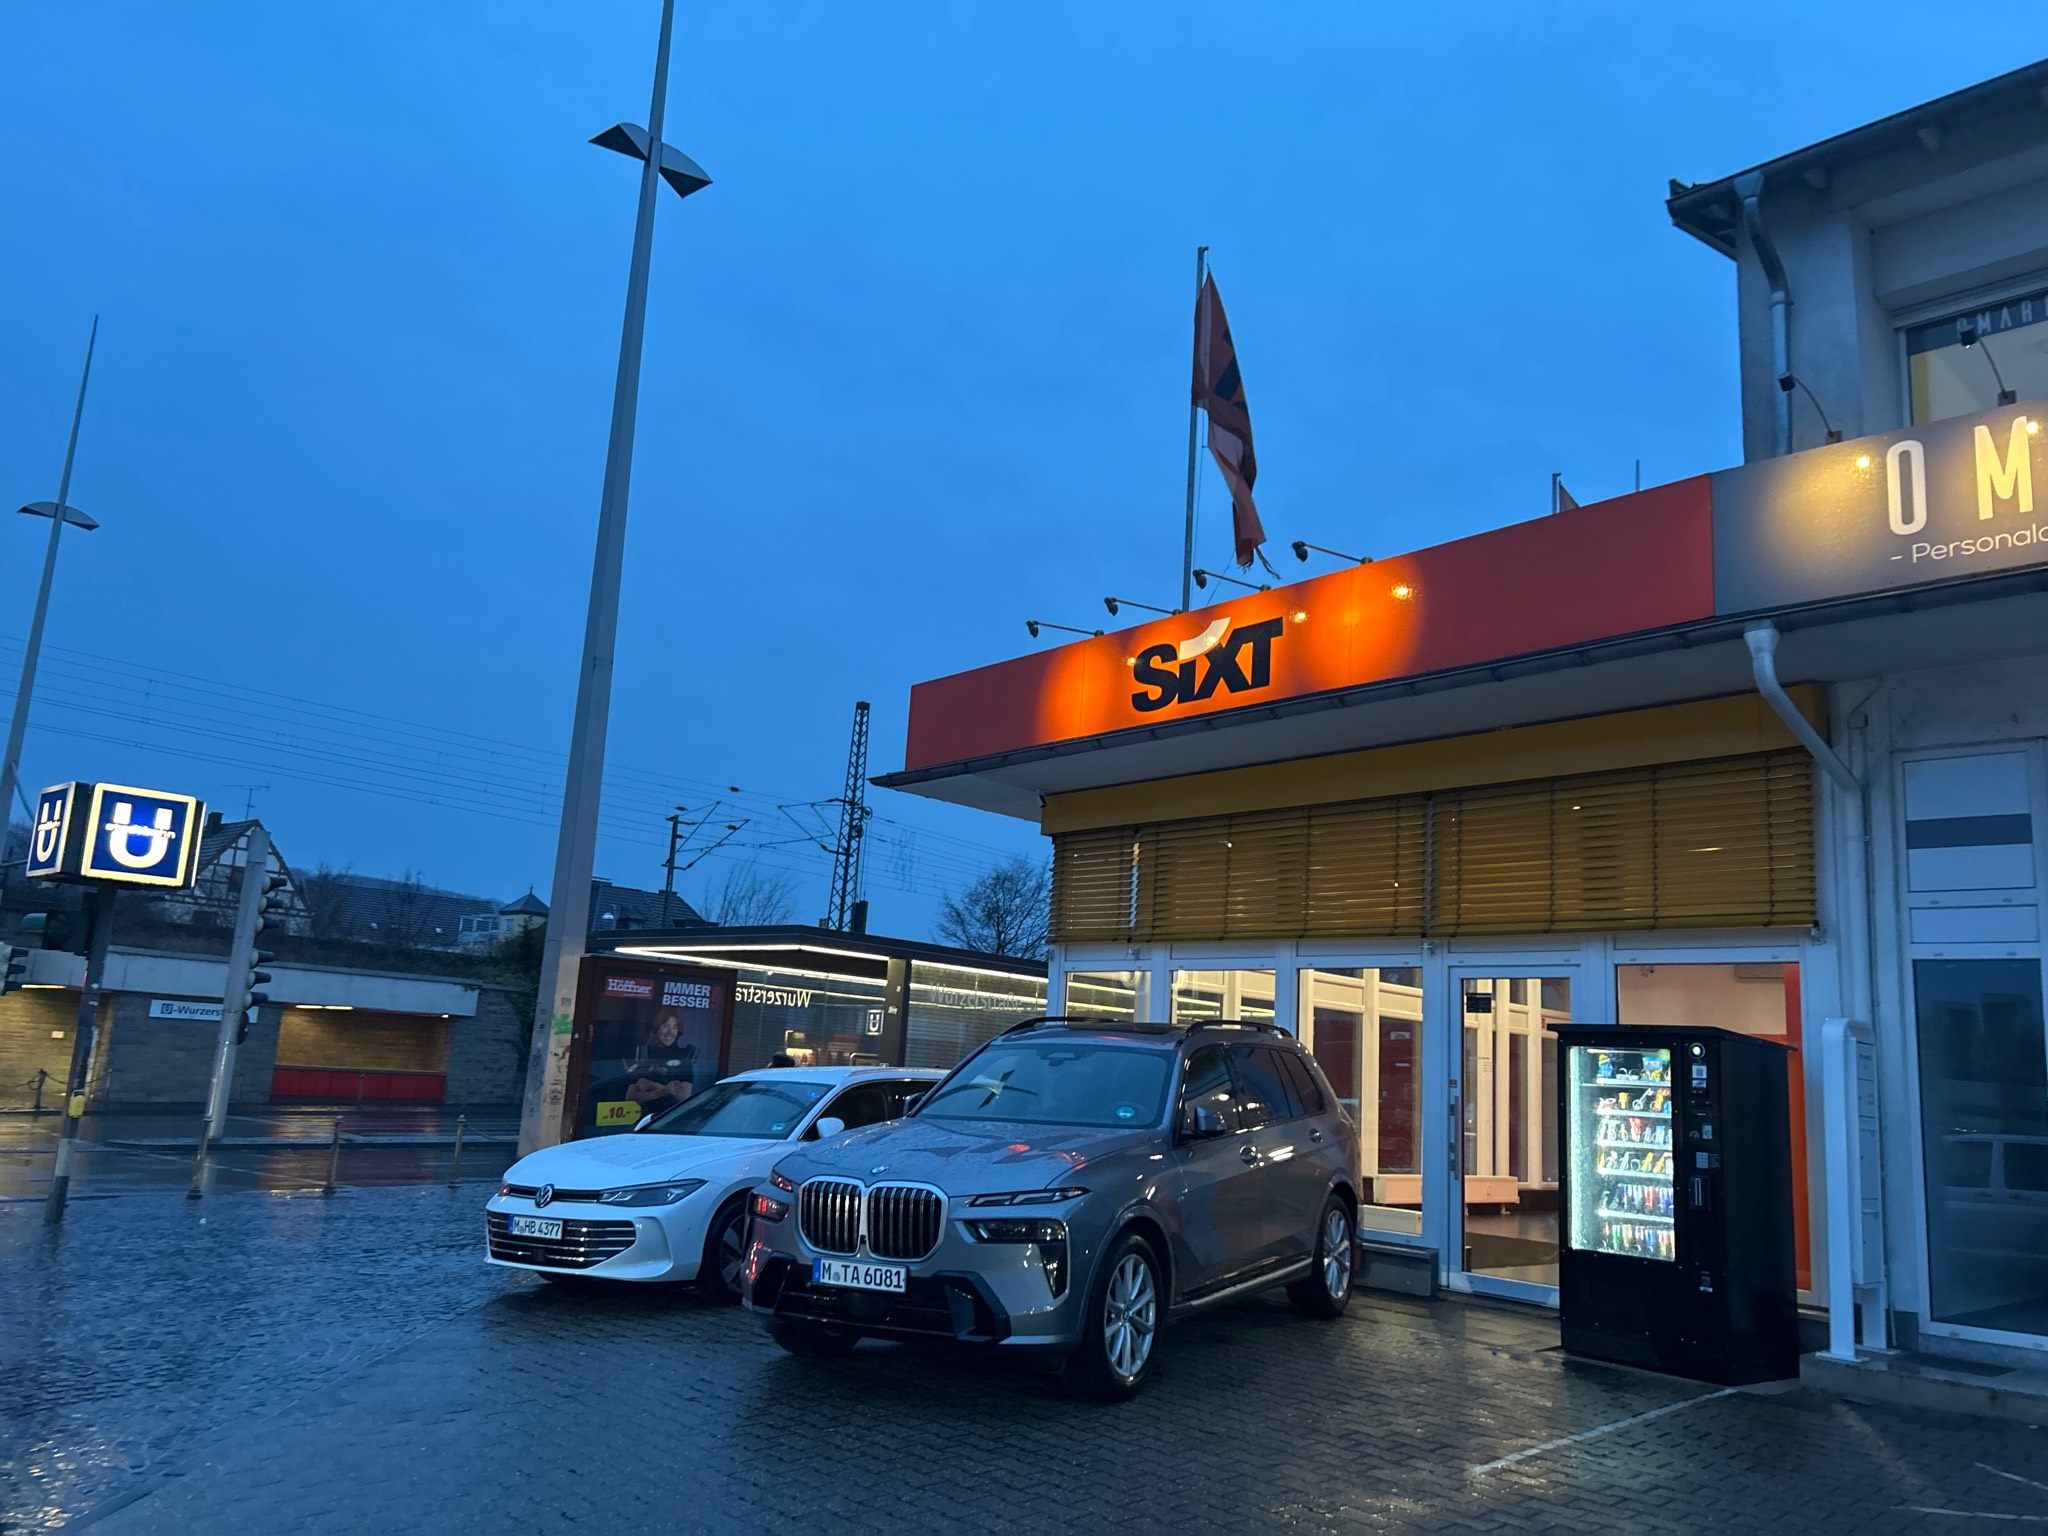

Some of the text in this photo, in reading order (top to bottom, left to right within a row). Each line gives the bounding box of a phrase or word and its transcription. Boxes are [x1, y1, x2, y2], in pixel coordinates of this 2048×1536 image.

[1956, 294, 2048, 340] OMAR
[663, 981, 711, 997] IMMER
[538, 1223, 561, 1238] 4377
[841, 1264, 860, 1285] TA
[864, 1267, 903, 1289] 6081
